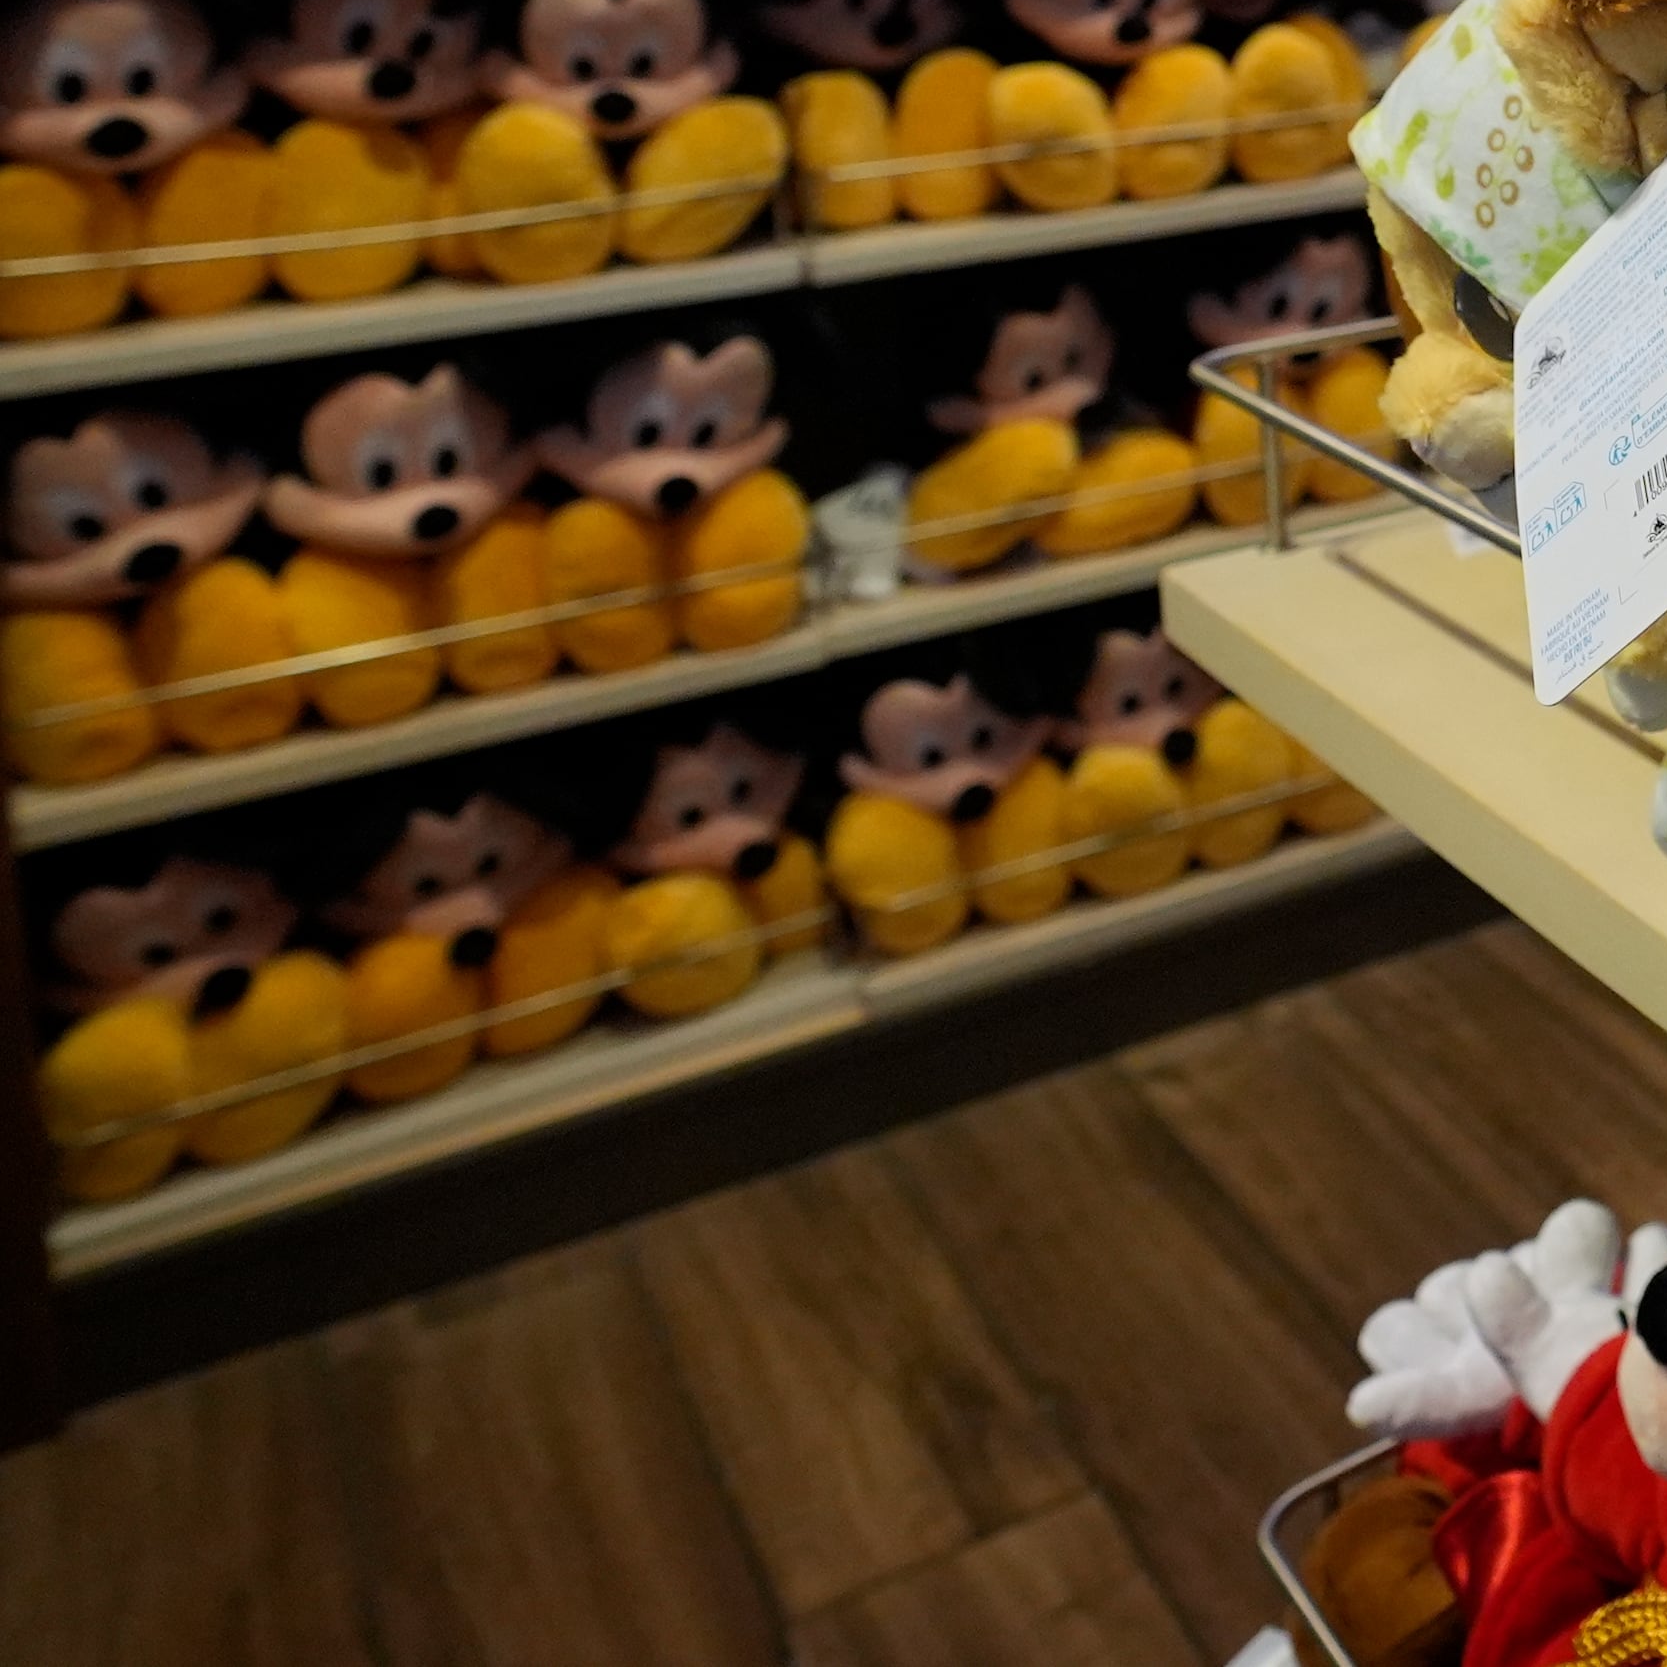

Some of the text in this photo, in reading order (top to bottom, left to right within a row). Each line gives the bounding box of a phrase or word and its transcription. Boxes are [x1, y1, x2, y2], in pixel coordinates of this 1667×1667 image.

[1578, 328, 1664, 412] disneylandparis.com
[1573, 587, 1601, 617] VIETNAM
[1582, 592, 1610, 621] VIETNAM
[1578, 609, 1607, 638] VIETNAM
